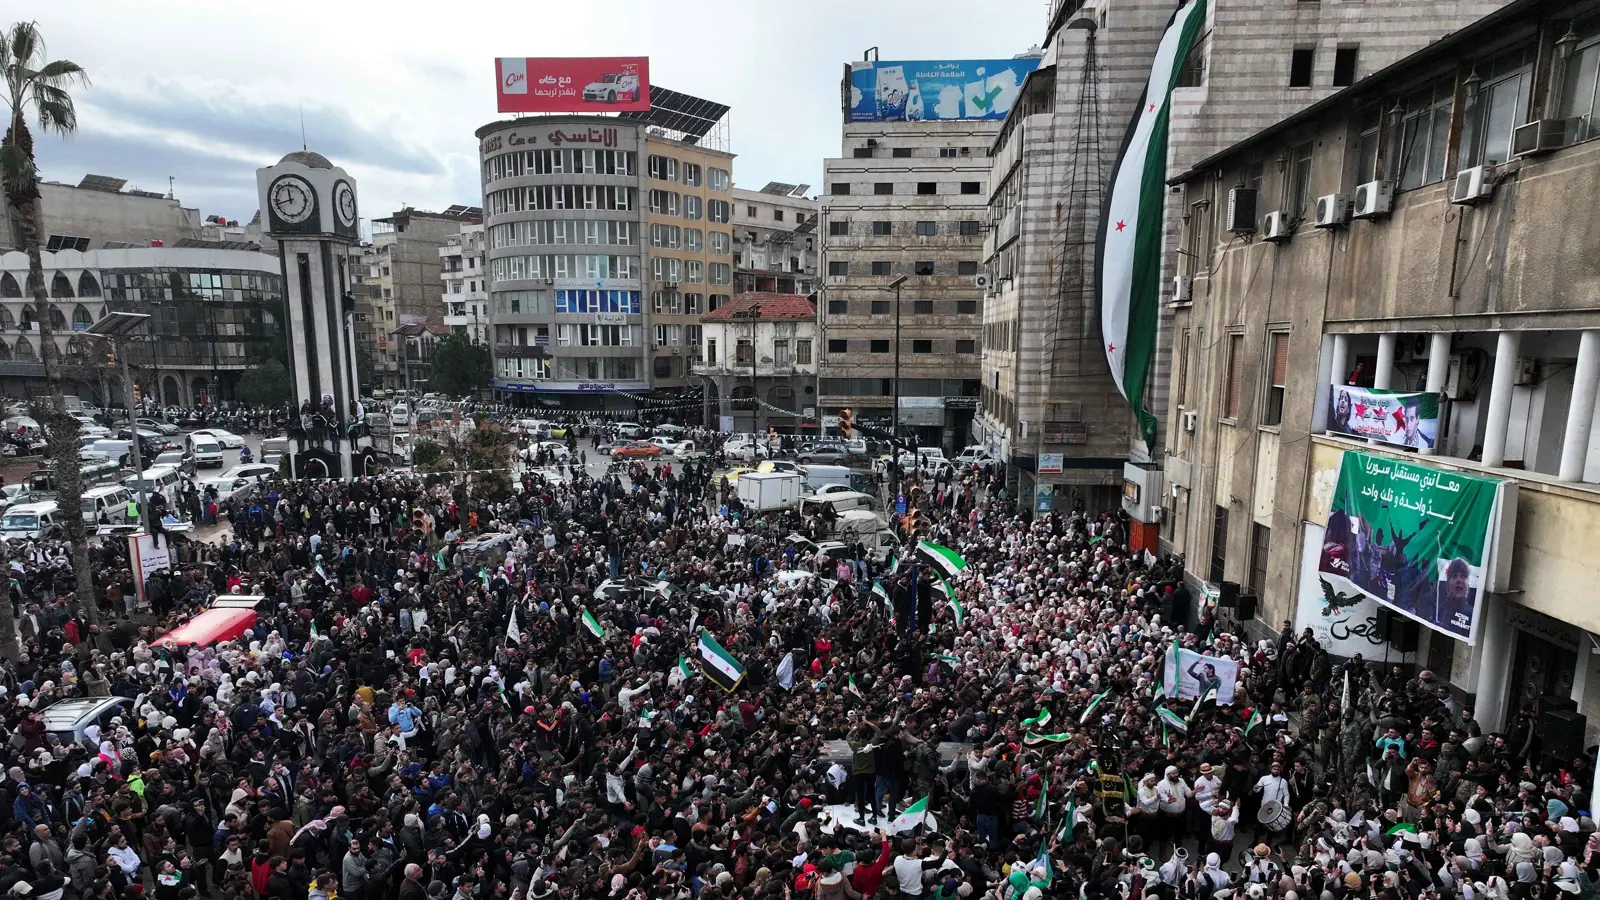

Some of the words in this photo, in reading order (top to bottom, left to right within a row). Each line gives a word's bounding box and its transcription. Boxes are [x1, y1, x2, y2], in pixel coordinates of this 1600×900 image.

[558, 76, 572, 88] مع
[1366, 456, 1391, 476] سوريا
[1390, 462, 1420, 483] مستقبل
[1419, 472, 1437, 492] نبني
[1361, 483, 1379, 502] واحد
[1393, 495, 1399, 508] و
[1399, 491, 1427, 517] واحدة
